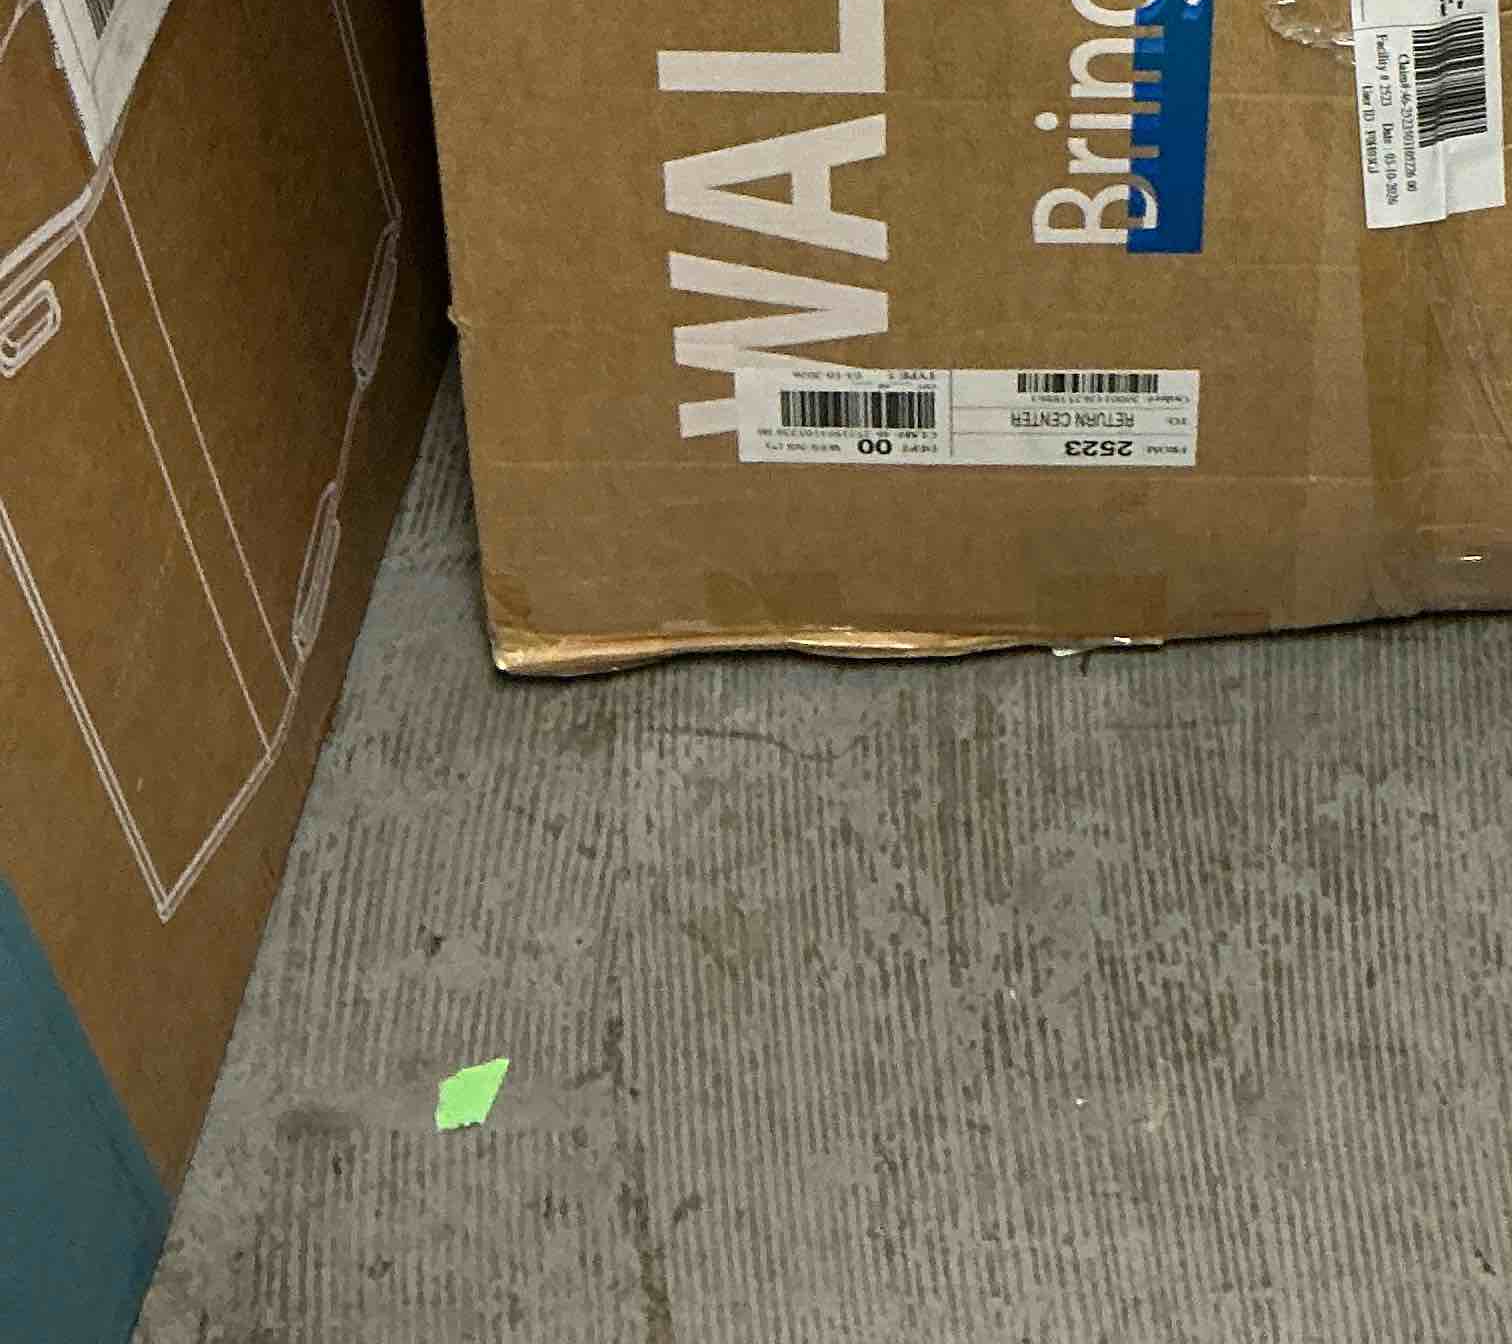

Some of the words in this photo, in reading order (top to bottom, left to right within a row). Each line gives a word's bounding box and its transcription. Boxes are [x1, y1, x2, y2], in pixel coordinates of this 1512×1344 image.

[1374, 33, 1389, 71] Facility
[1380, 83, 1391, 107] 2523
[1010, 411, 1071, 426] CENTER
[1073, 411, 1135, 426] RETURN
[856, 438, 891, 454] 00
[1063, 439, 1133, 456] 2523
